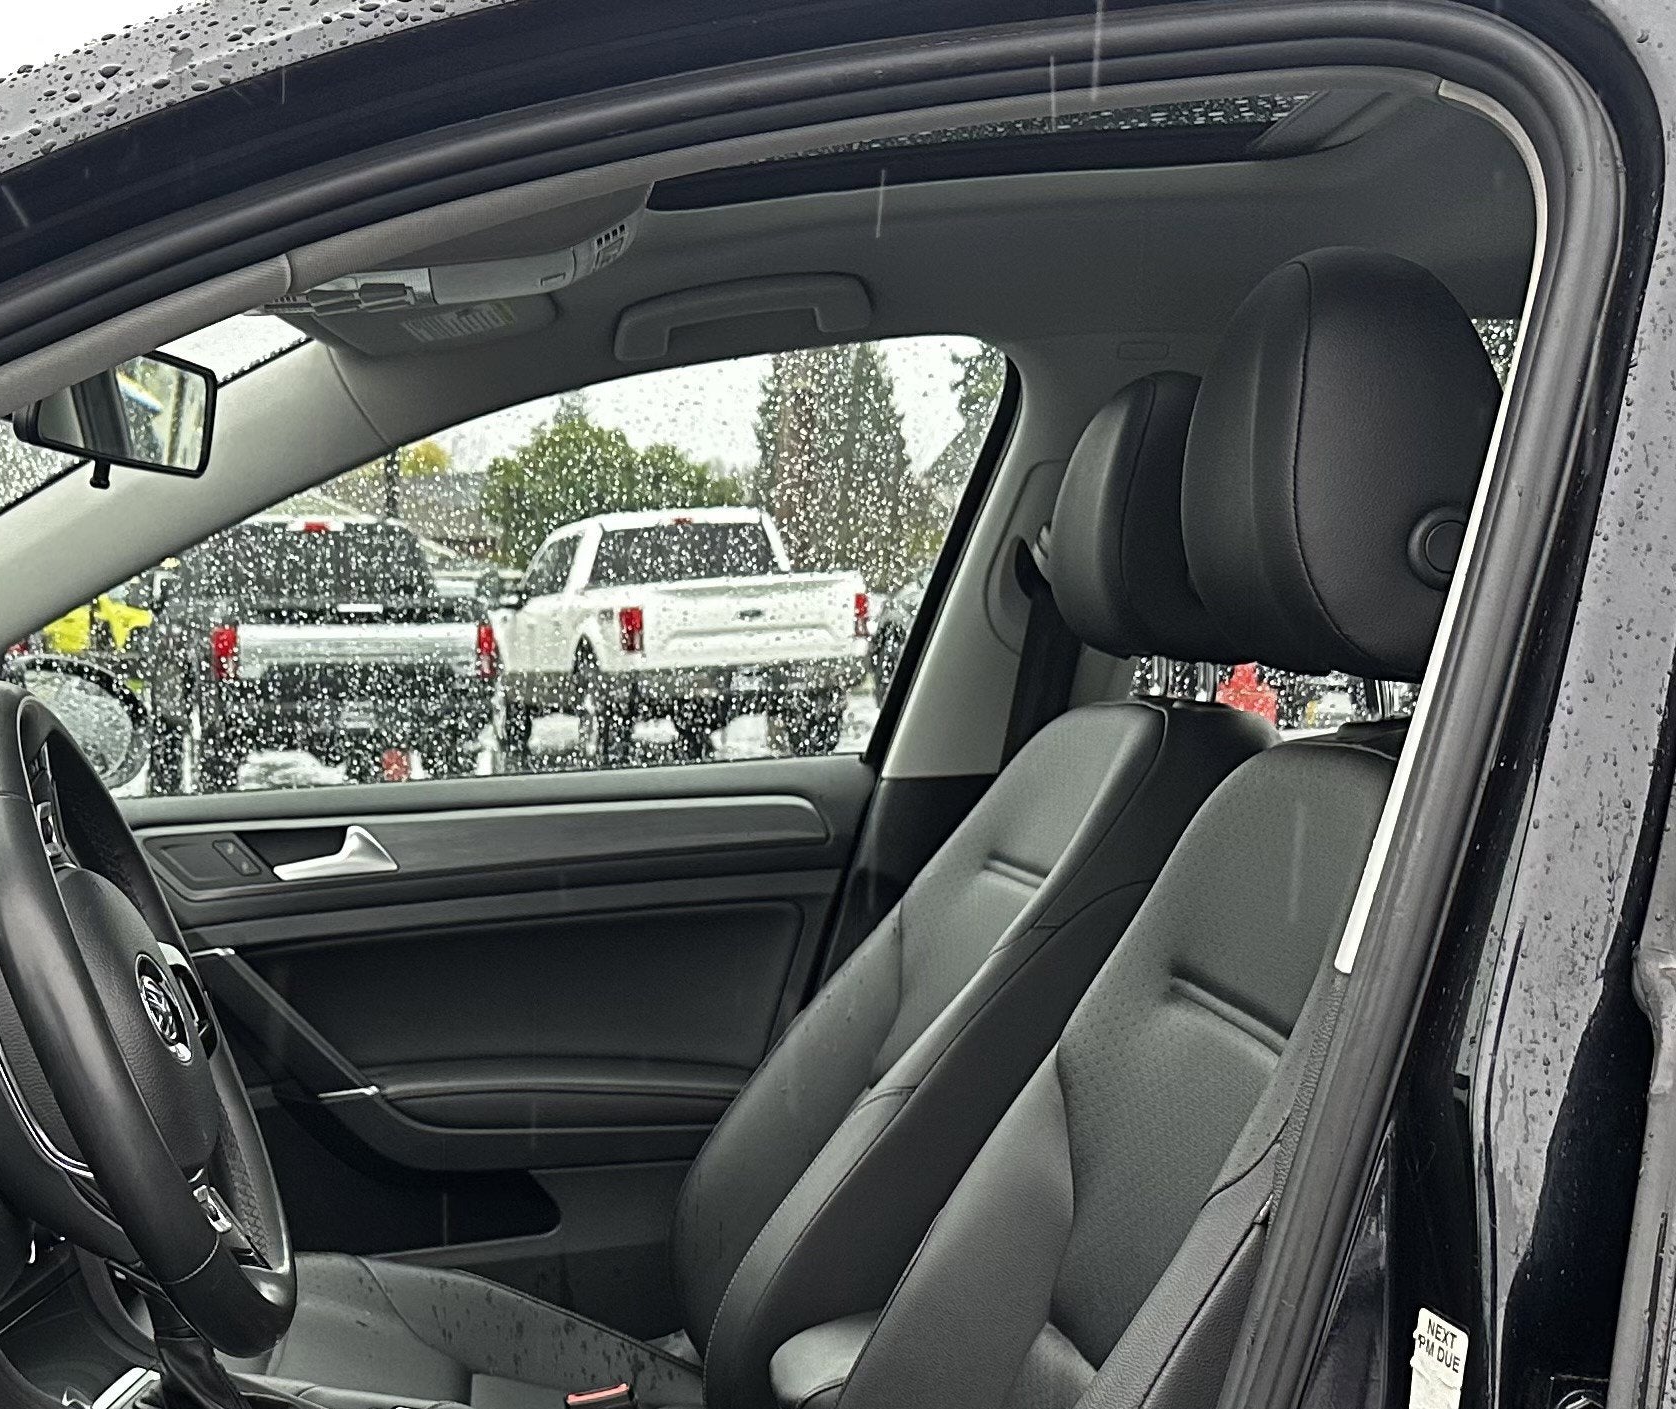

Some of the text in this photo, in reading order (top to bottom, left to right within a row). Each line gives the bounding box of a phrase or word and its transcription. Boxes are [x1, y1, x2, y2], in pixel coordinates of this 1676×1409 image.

[1427, 1318, 1458, 1350] NEXT
[1418, 1333, 1460, 1374] PM DUE
